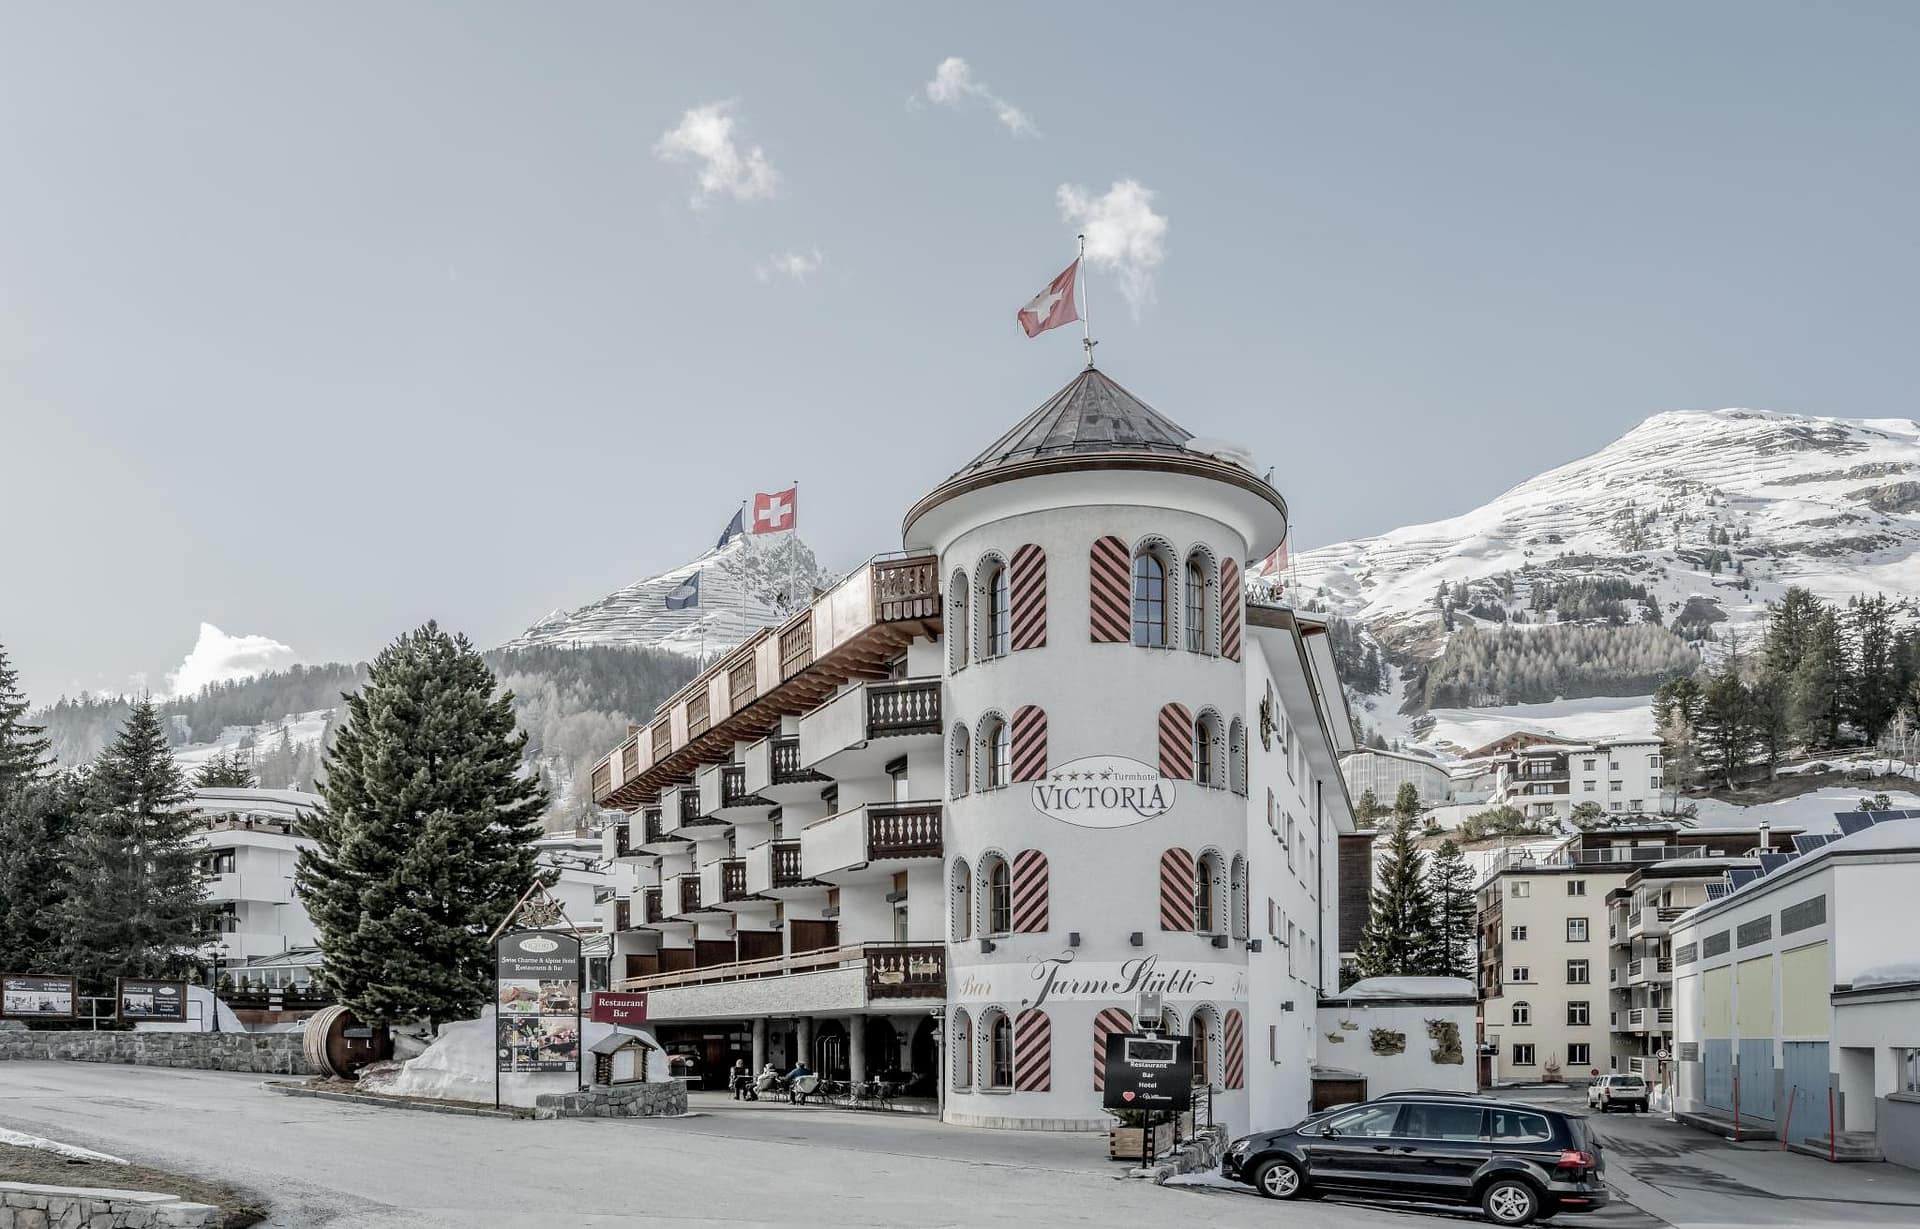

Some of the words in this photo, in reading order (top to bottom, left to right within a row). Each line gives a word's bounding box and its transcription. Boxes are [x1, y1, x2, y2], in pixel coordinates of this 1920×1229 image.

[1114, 772, 1158, 781] Turmhotel
[1035, 783, 1169, 817] VICTORIA
[599, 998, 644, 1007] Restaurant
[613, 1009, 629, 1017] Bar
[1131, 1060, 1167, 1069] Restaurant
